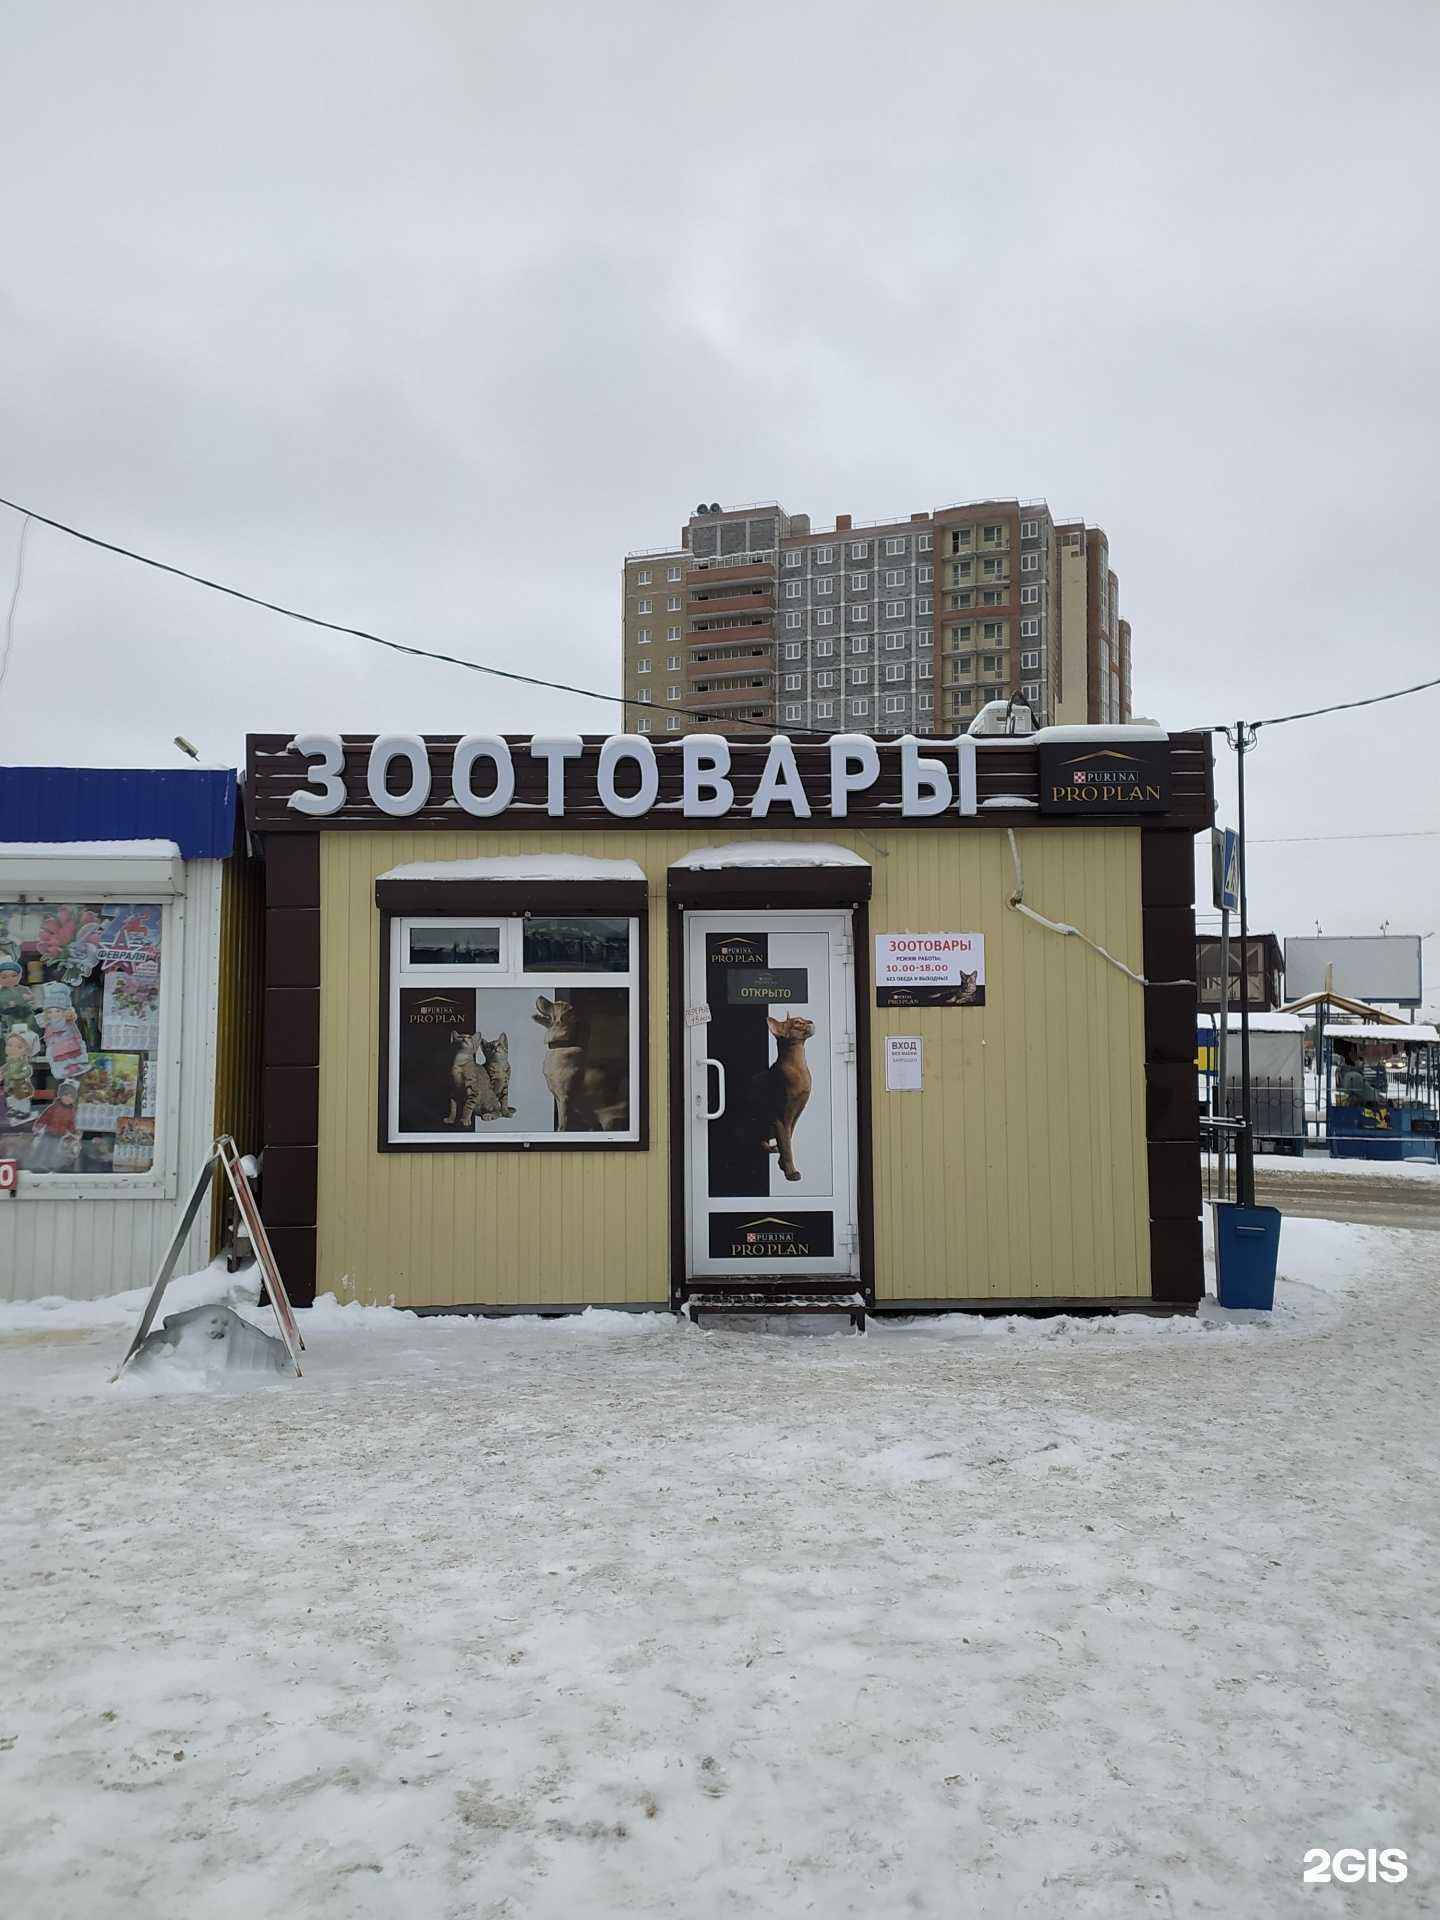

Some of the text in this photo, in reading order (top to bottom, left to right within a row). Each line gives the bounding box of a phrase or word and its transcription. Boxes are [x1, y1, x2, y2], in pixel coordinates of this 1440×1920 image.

[287, 734, 977, 818] ЗООТОВАРЫ
[1087, 772, 1137, 782] PURINA
[1052, 785, 1160, 801] PRO PLAN
[889, 940, 972, 952] ЗООТОВАРЫ
[97, 950, 146, 961] ФЕВРАЛЯ
[711, 954, 763, 963] PRO PLAN
[741, 987, 792, 999] ОТКРЫТО
[409, 1014, 465, 1024] PRO PLAN
[891, 1041, 917, 1051] ВХОД
[757, 1233, 793, 1241] PURINA
[731, 1243, 810, 1256] PRO PLAN
